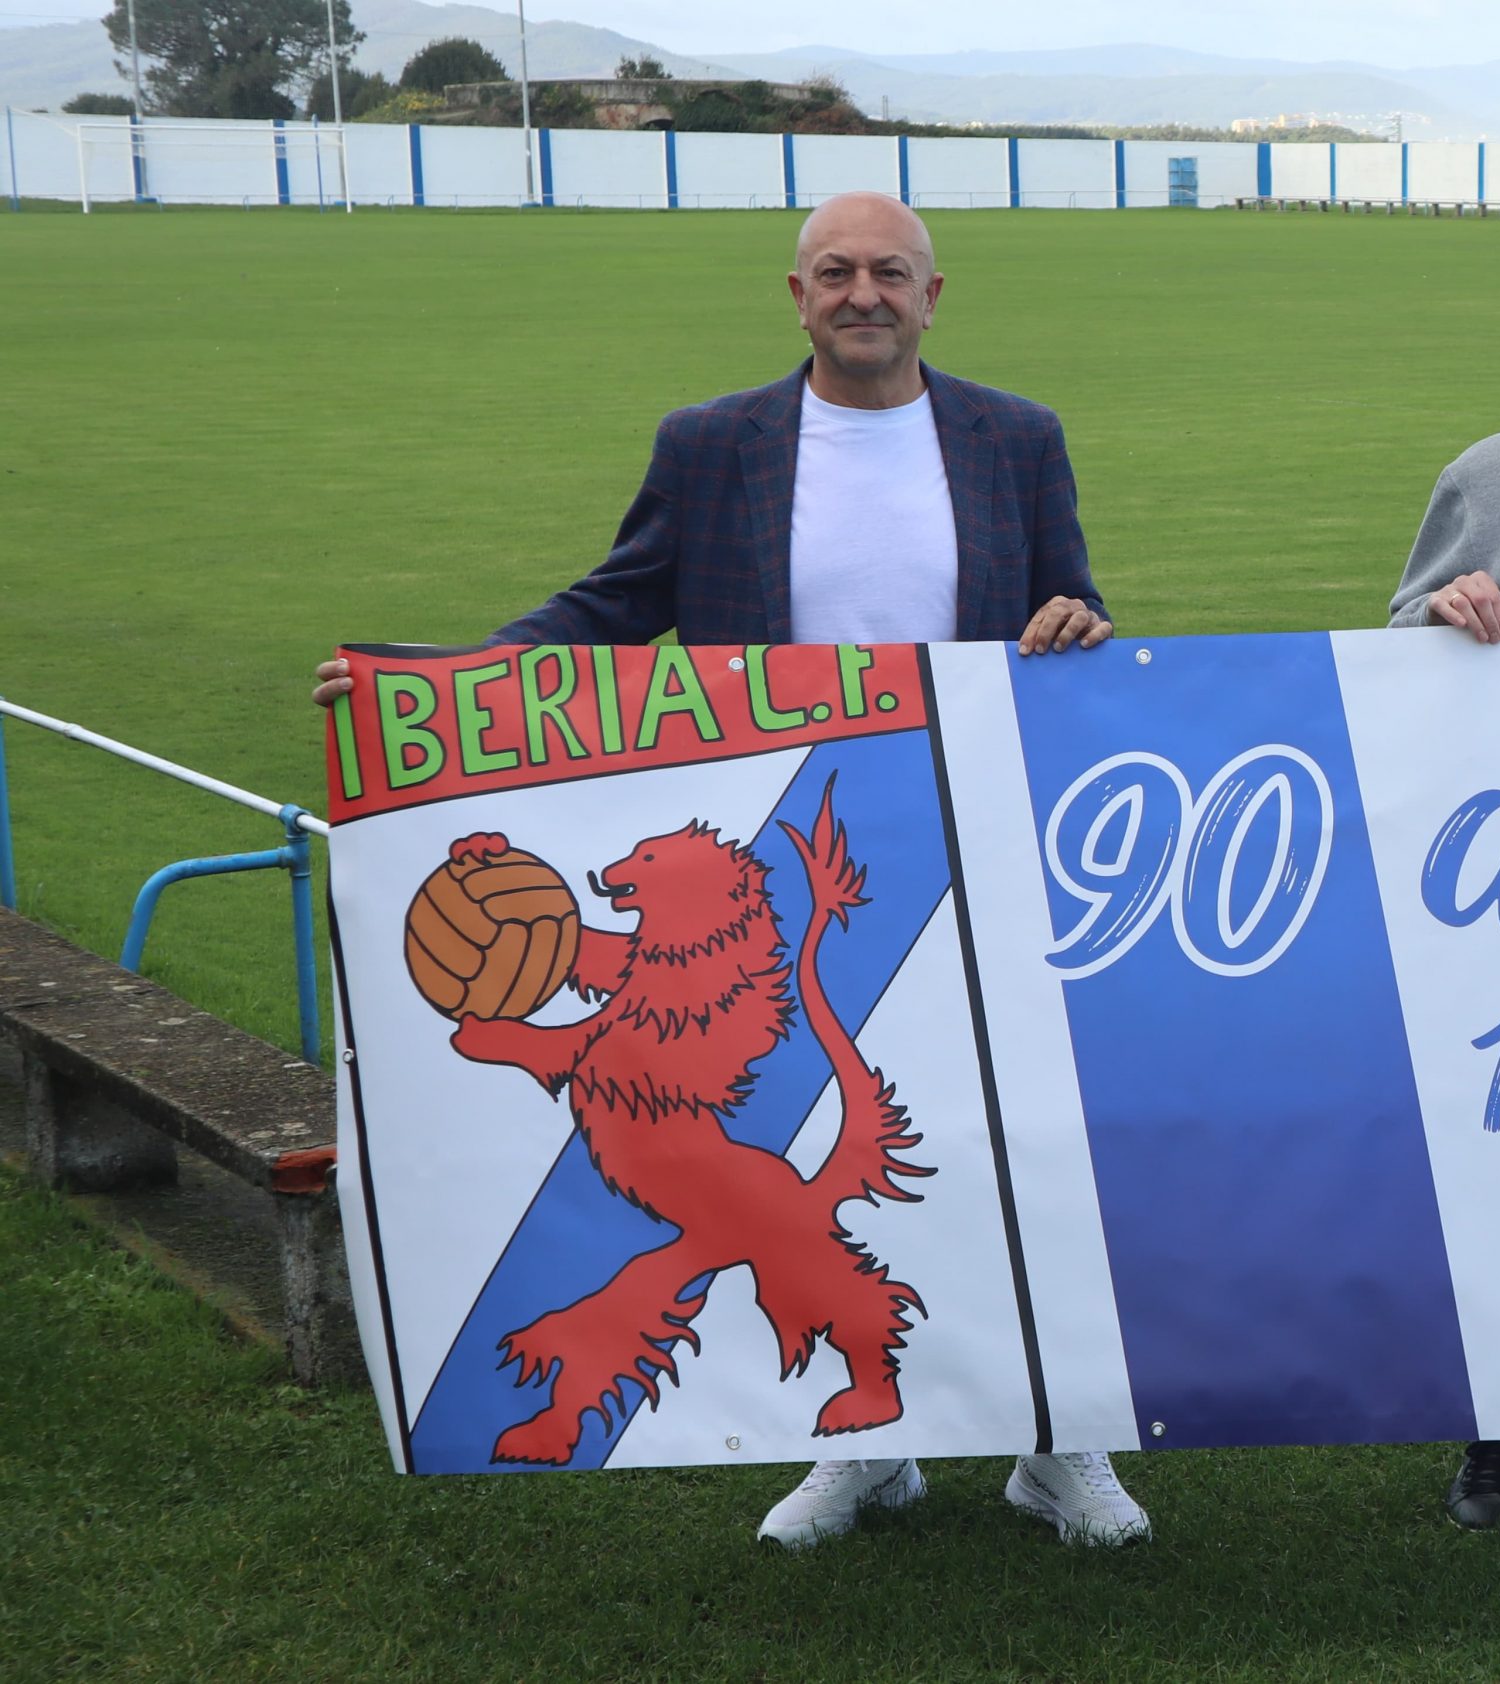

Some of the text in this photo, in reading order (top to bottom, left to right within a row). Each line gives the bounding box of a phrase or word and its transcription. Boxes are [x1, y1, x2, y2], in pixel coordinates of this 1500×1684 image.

[333, 643, 899, 799] IBERIA C.F.
[1045, 744, 1335, 980] 90
